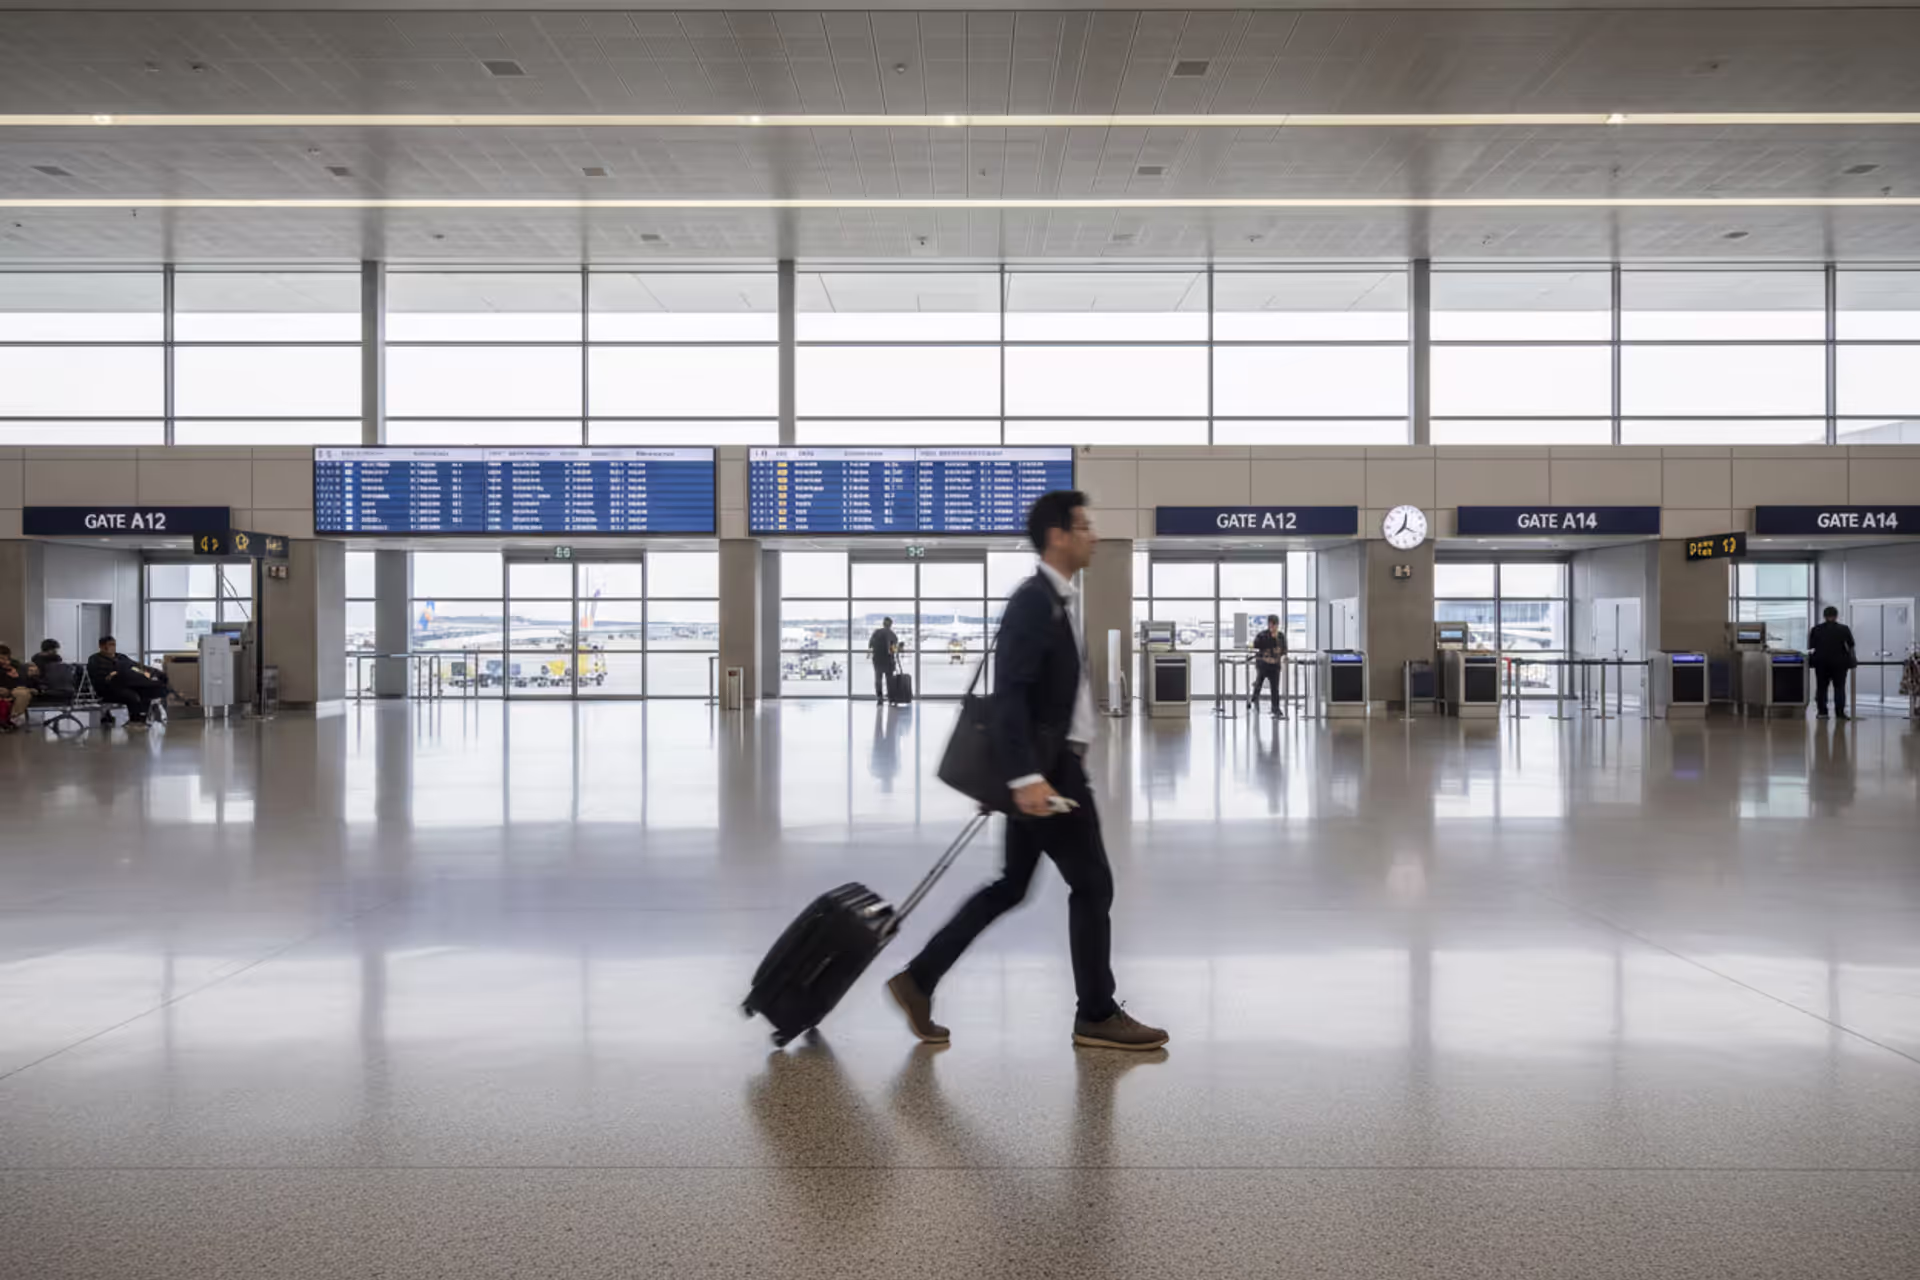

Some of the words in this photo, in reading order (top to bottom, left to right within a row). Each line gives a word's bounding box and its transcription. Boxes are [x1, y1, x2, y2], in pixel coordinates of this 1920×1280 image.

[84, 513, 126, 529] GATE
[131, 512, 166, 530] A12
[1216, 513, 1257, 529] GATE
[1261, 512, 1297, 530] A12
[1517, 513, 1558, 529] GATE
[1562, 512, 1598, 529] A14
[1817, 513, 1859, 529] GATE
[1862, 512, 1898, 529] A14
